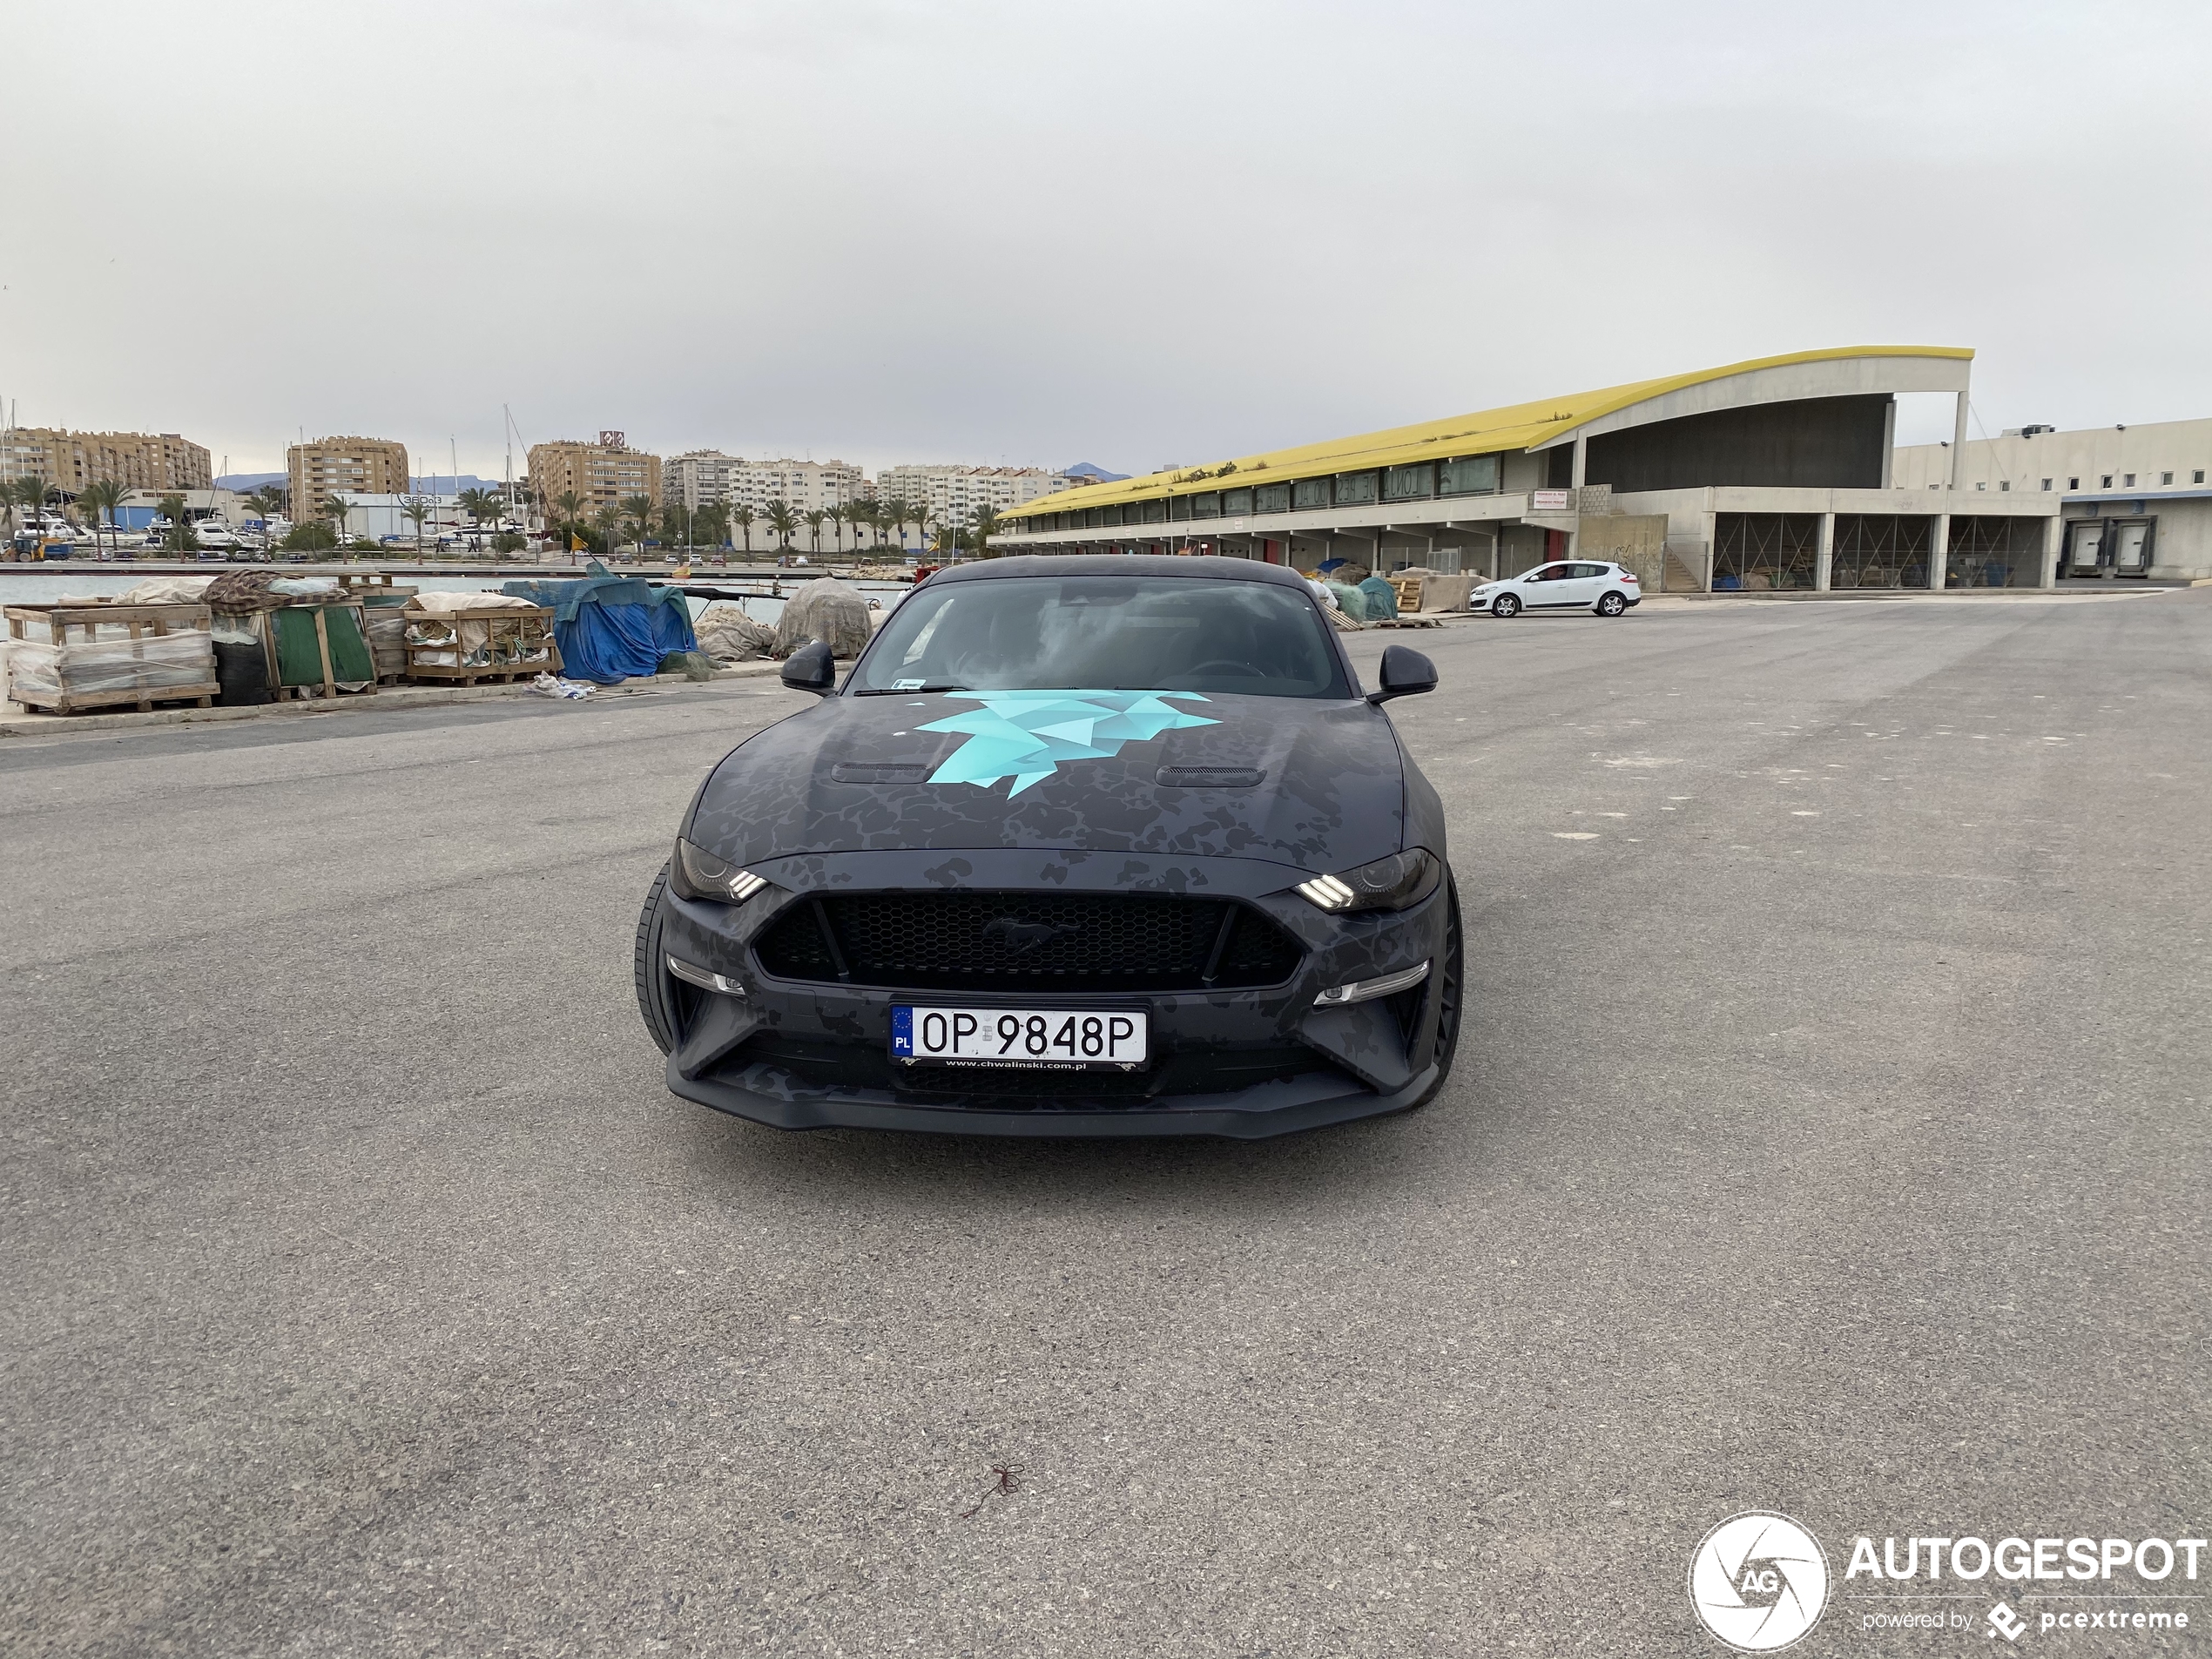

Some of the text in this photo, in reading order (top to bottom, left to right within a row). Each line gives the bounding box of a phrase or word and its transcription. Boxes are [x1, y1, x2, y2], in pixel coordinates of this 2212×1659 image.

[895, 1013, 1134, 1057] PL OP 9848P
[946, 1060, 1087, 1071] www.chwalinski.com.pl
